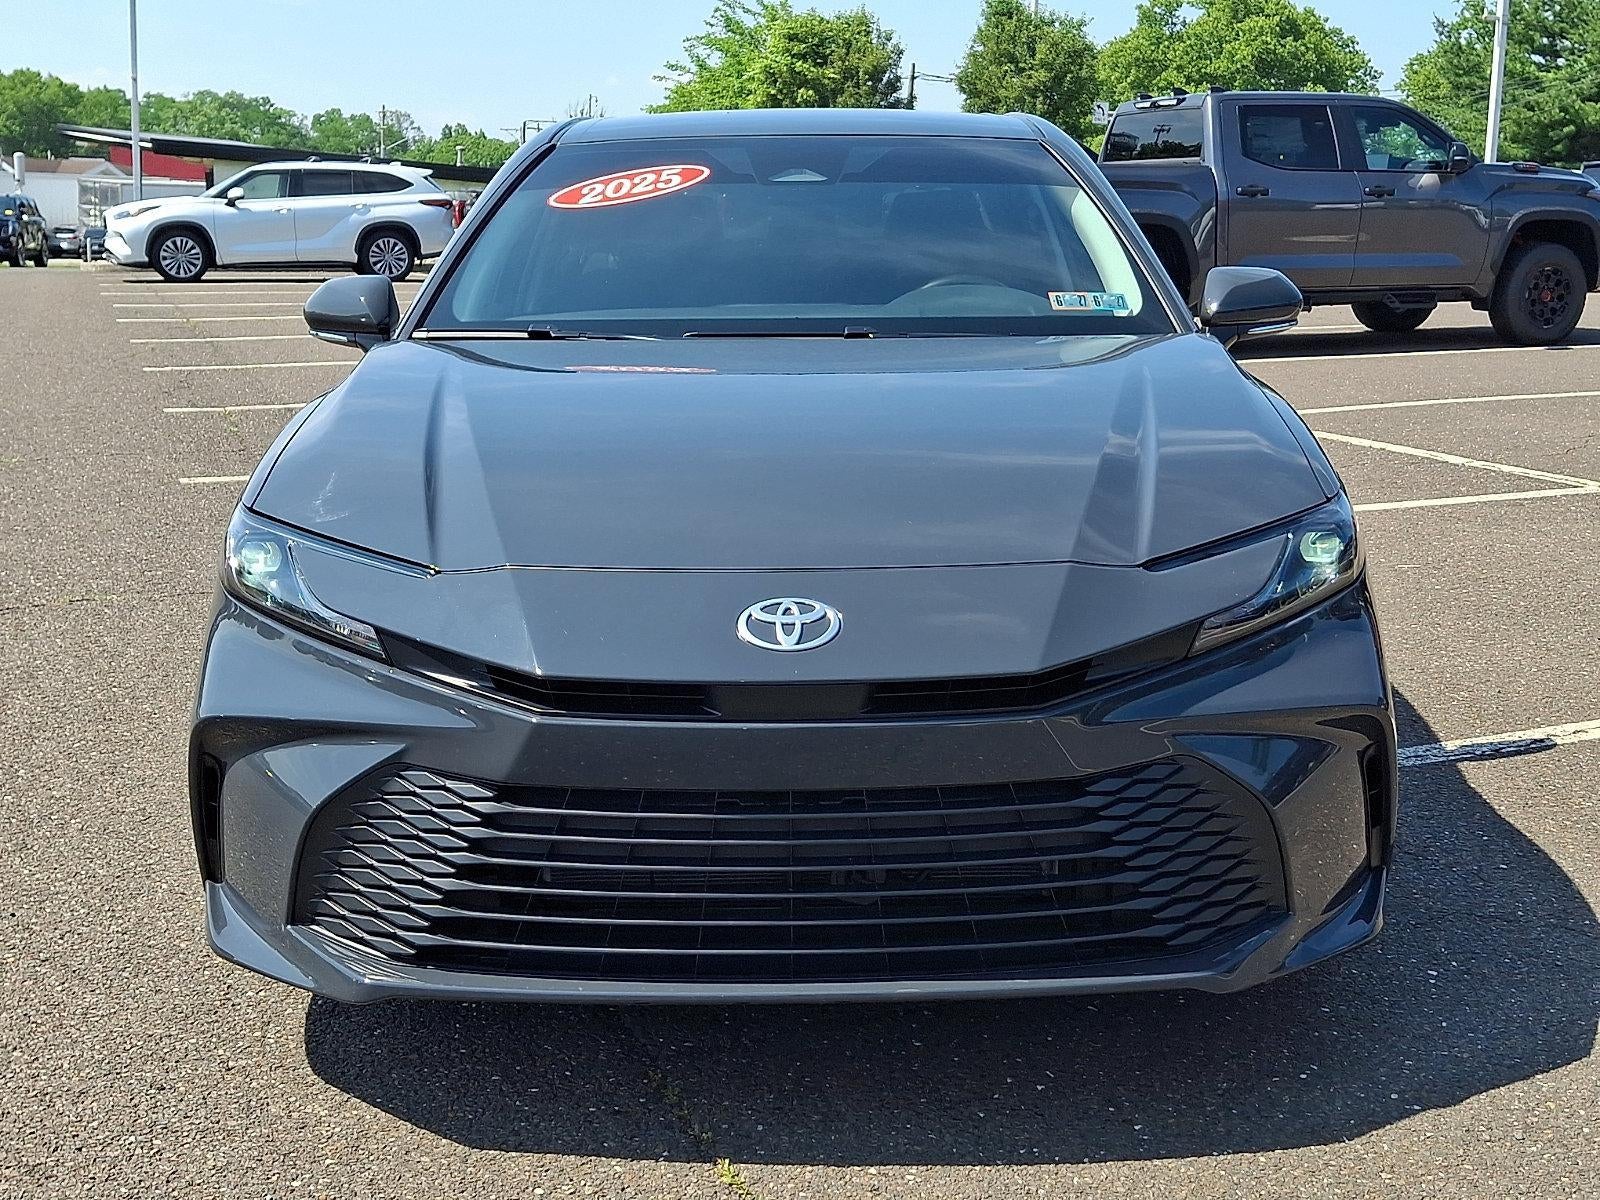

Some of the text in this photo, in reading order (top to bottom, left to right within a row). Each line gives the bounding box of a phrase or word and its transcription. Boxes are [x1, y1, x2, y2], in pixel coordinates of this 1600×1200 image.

[578, 168, 683, 205] 2025
[1055, 294, 1064, 307] 6
[1077, 294, 1087, 307] 27
[1093, 294, 1101, 307] 6
